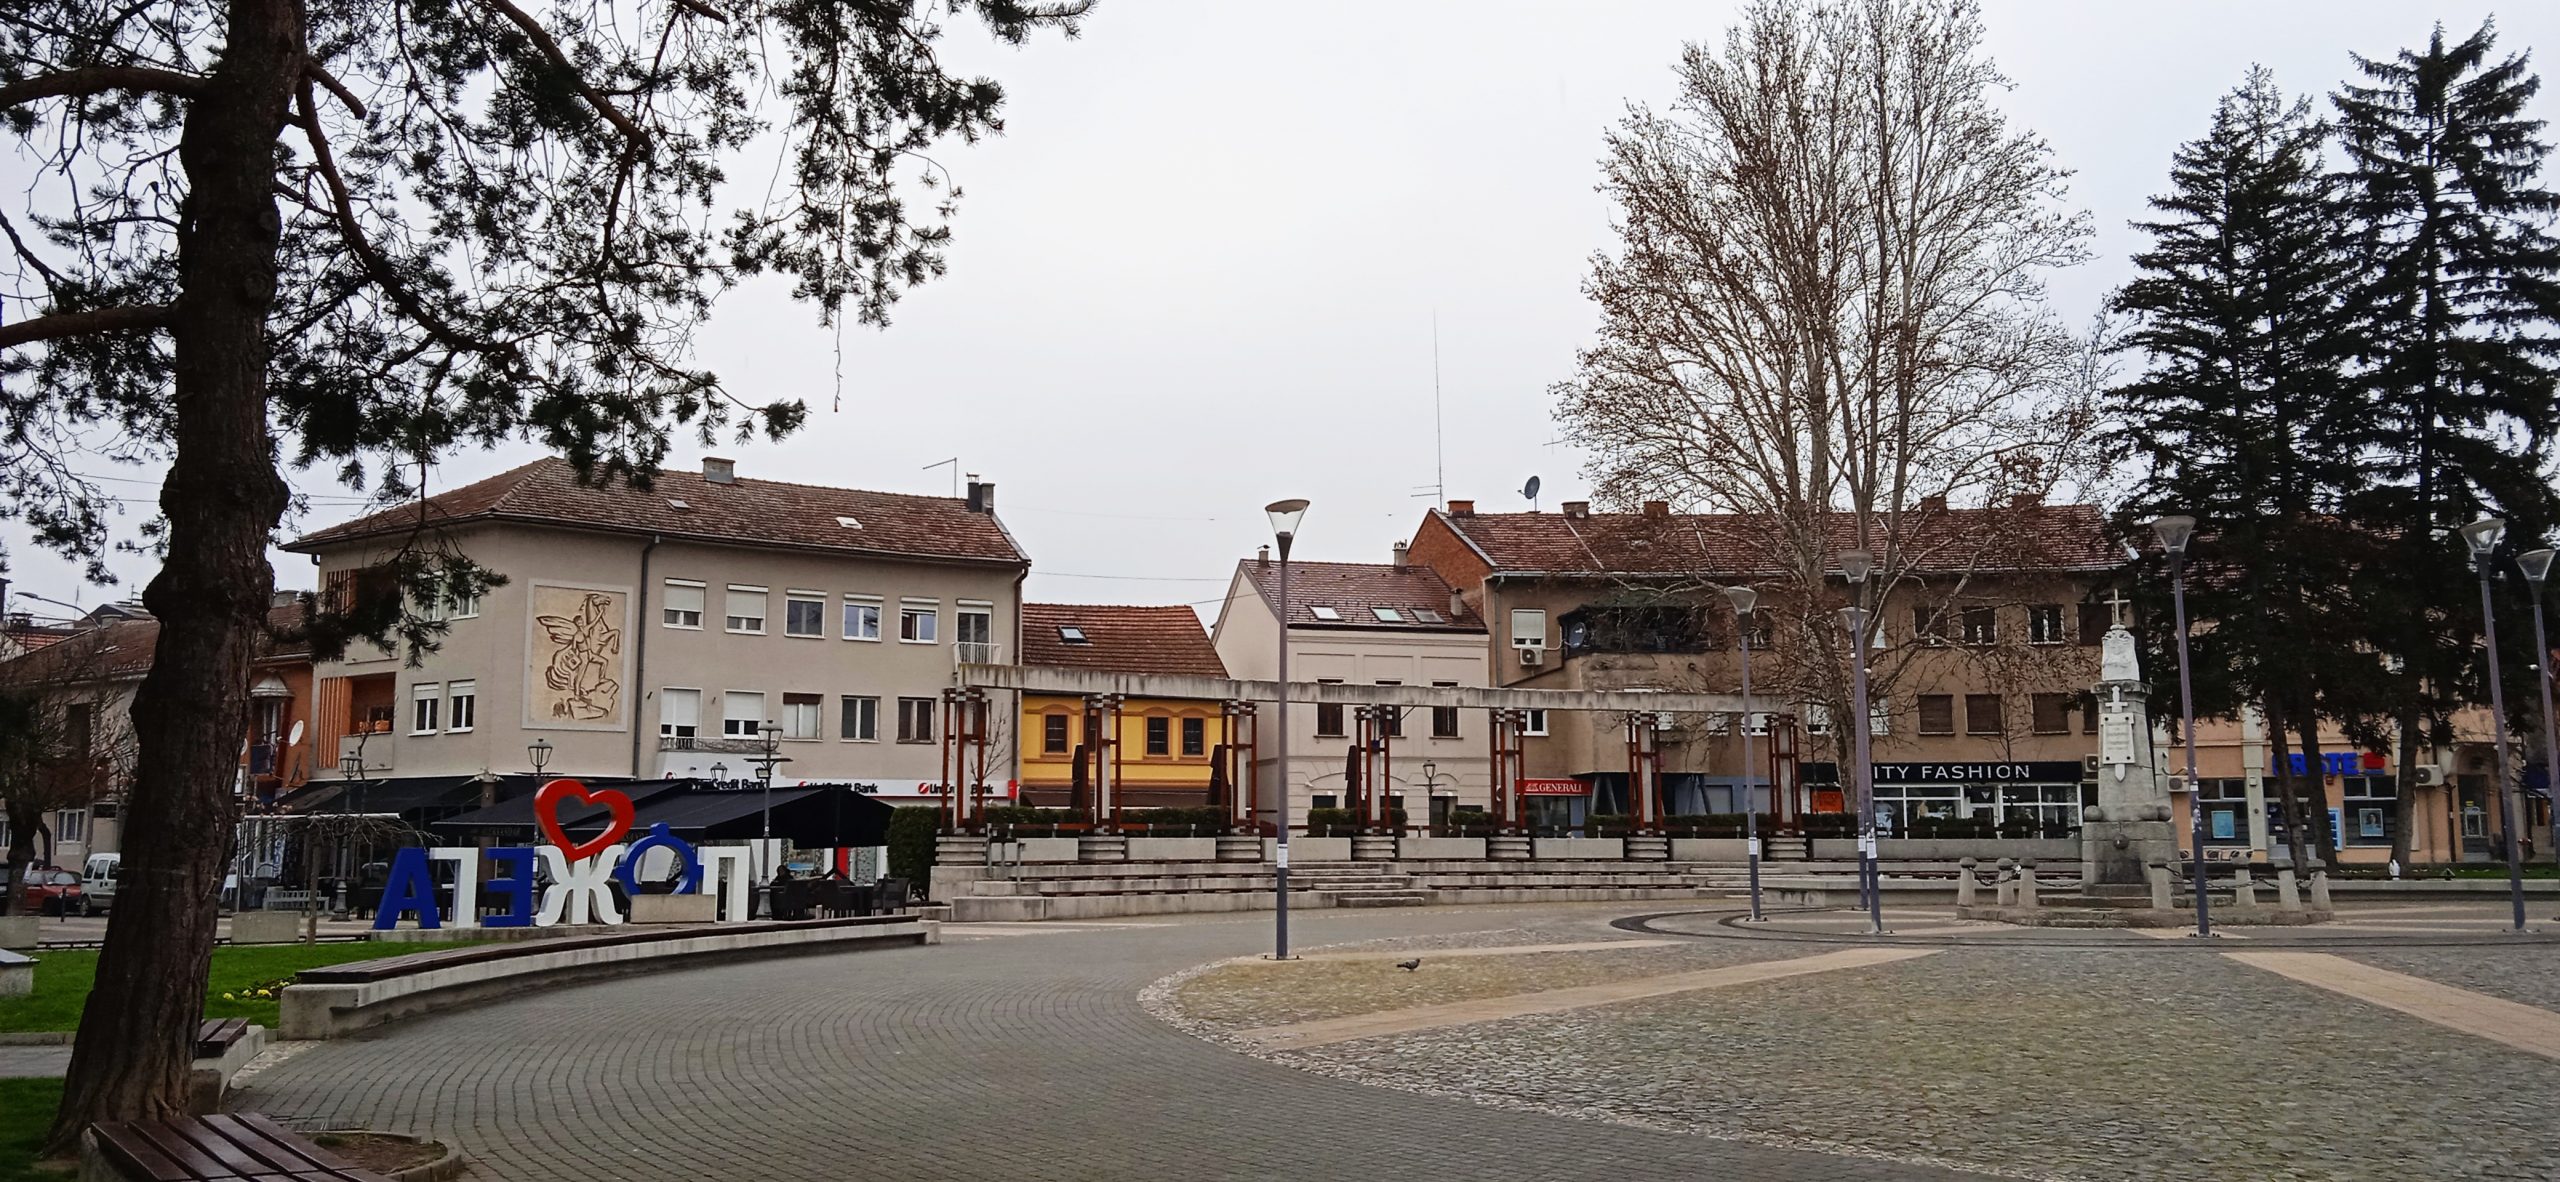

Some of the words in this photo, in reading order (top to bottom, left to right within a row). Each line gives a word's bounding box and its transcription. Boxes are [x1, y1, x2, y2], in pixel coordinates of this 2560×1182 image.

[1874, 766, 1909, 779] ITY
[1922, 765, 2030, 779] FASHION
[693, 779, 739, 790] Credit
[854, 783, 878, 794] Bank
[971, 784, 994, 795] Bnk
[1539, 783, 1582, 793] GENERALI
